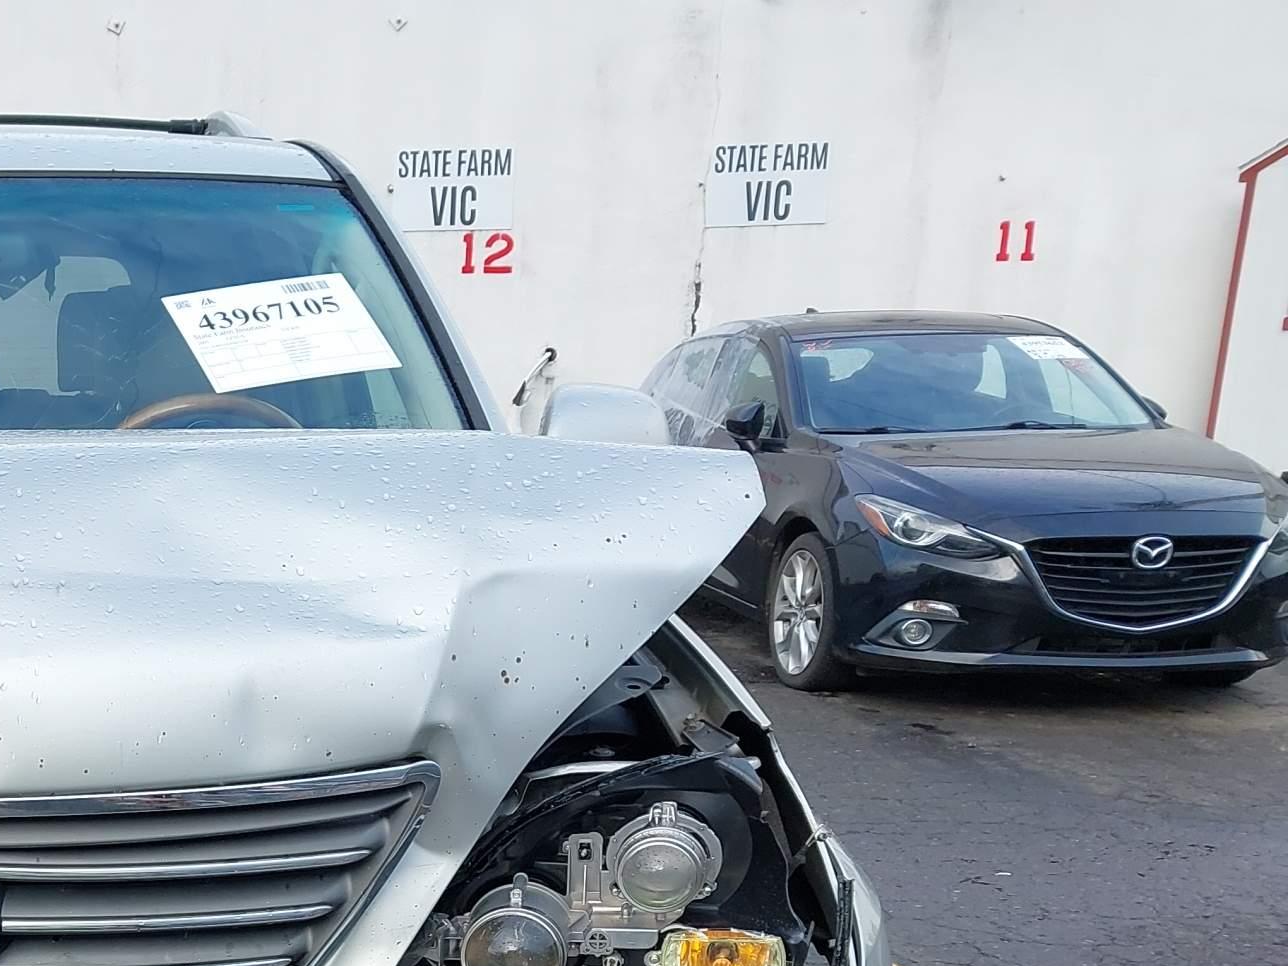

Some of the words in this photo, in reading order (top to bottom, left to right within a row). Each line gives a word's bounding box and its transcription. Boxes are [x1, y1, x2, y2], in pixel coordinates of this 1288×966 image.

[399, 150, 452, 178] STATE
[457, 148, 512, 177] FARM
[715, 143, 768, 174] STATE
[773, 142, 829, 171] FARM
[430, 185, 477, 226] VIC
[746, 180, 792, 222] VIC
[461, 232, 515, 275] 12
[995, 220, 1036, 263] 11
[199, 296, 341, 331] 43967105
